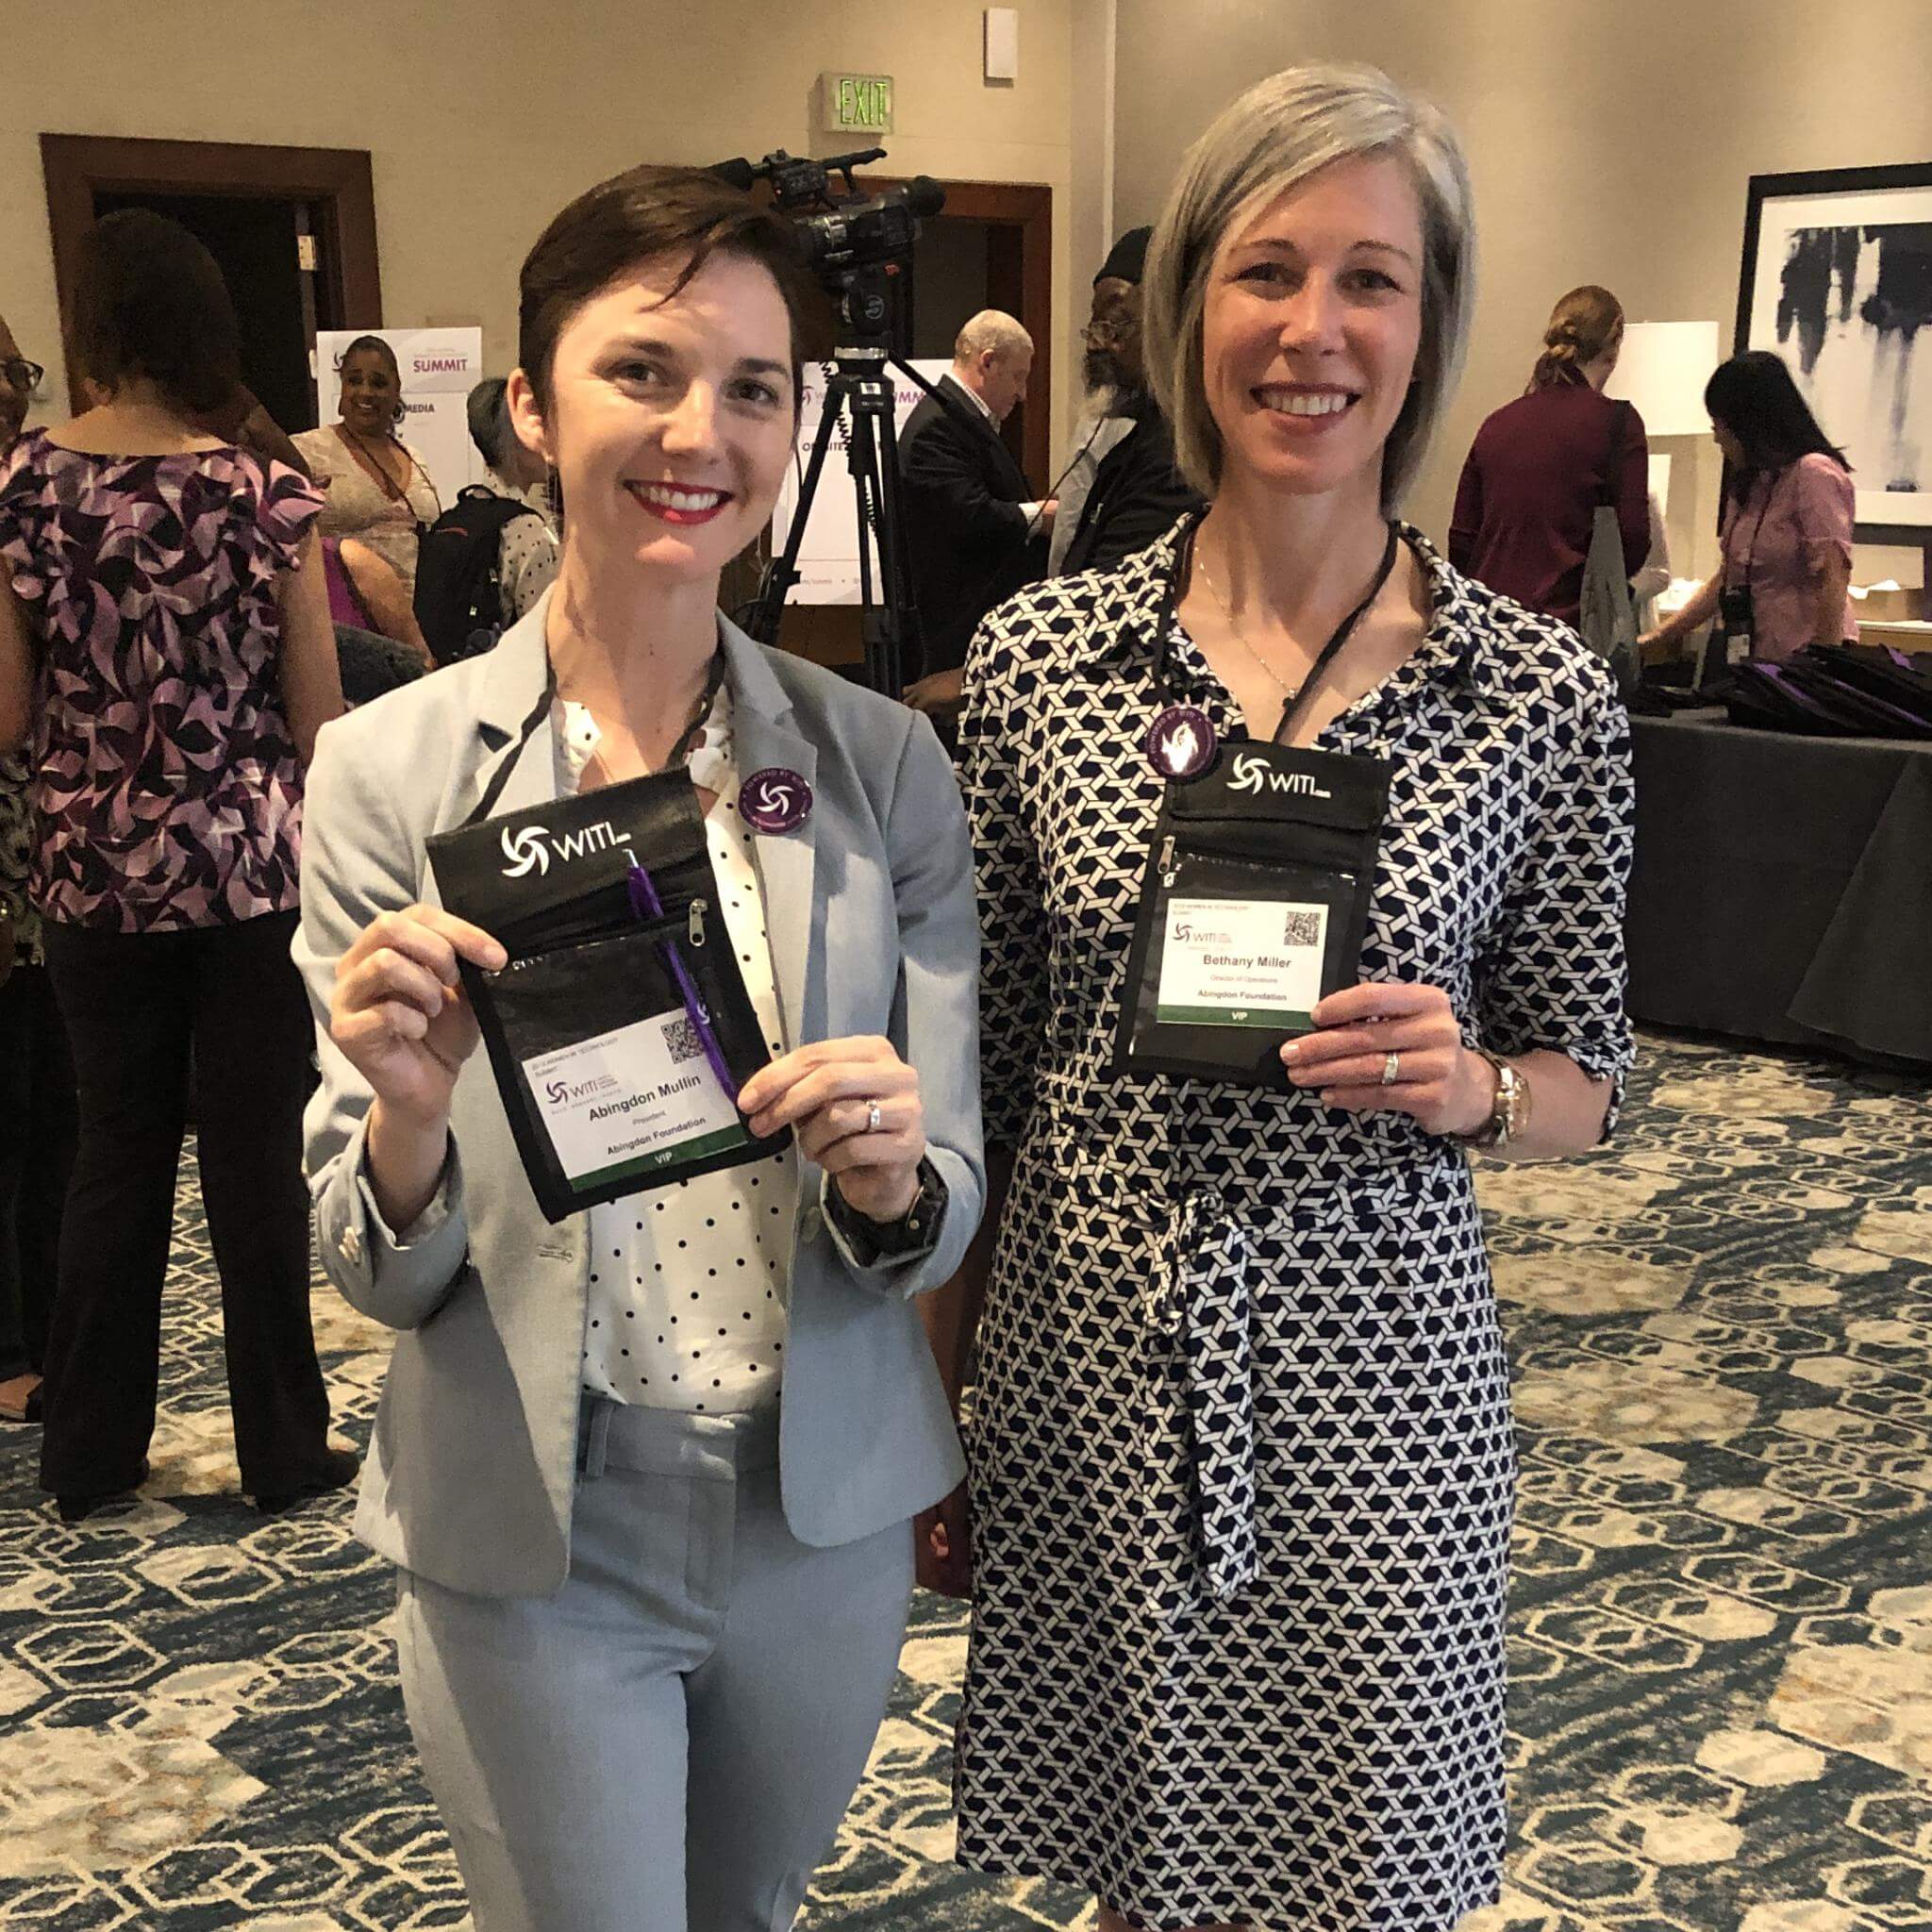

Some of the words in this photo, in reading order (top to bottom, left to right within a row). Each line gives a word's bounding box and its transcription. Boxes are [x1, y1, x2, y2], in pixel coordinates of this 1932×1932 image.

[841, 79, 887, 125] EXIT
[413, 358, 468, 373] SUMMIT
[1203, 954, 1254, 969] Bethany
[1257, 956, 1291, 969] Miller
[1197, 990, 1238, 999] Abingdon
[1240, 991, 1288, 1001] Foundation
[1231, 1011, 1248, 1021] VIP
[570, 1079, 599, 1098] WITI
[589, 1091, 657, 1121] Abingdon
[658, 1074, 702, 1097] Mullin
[608, 1135, 652, 1155] Abingdon
[654, 1117, 706, 1140] Foundation
[655, 1152, 673, 1164] VIP
